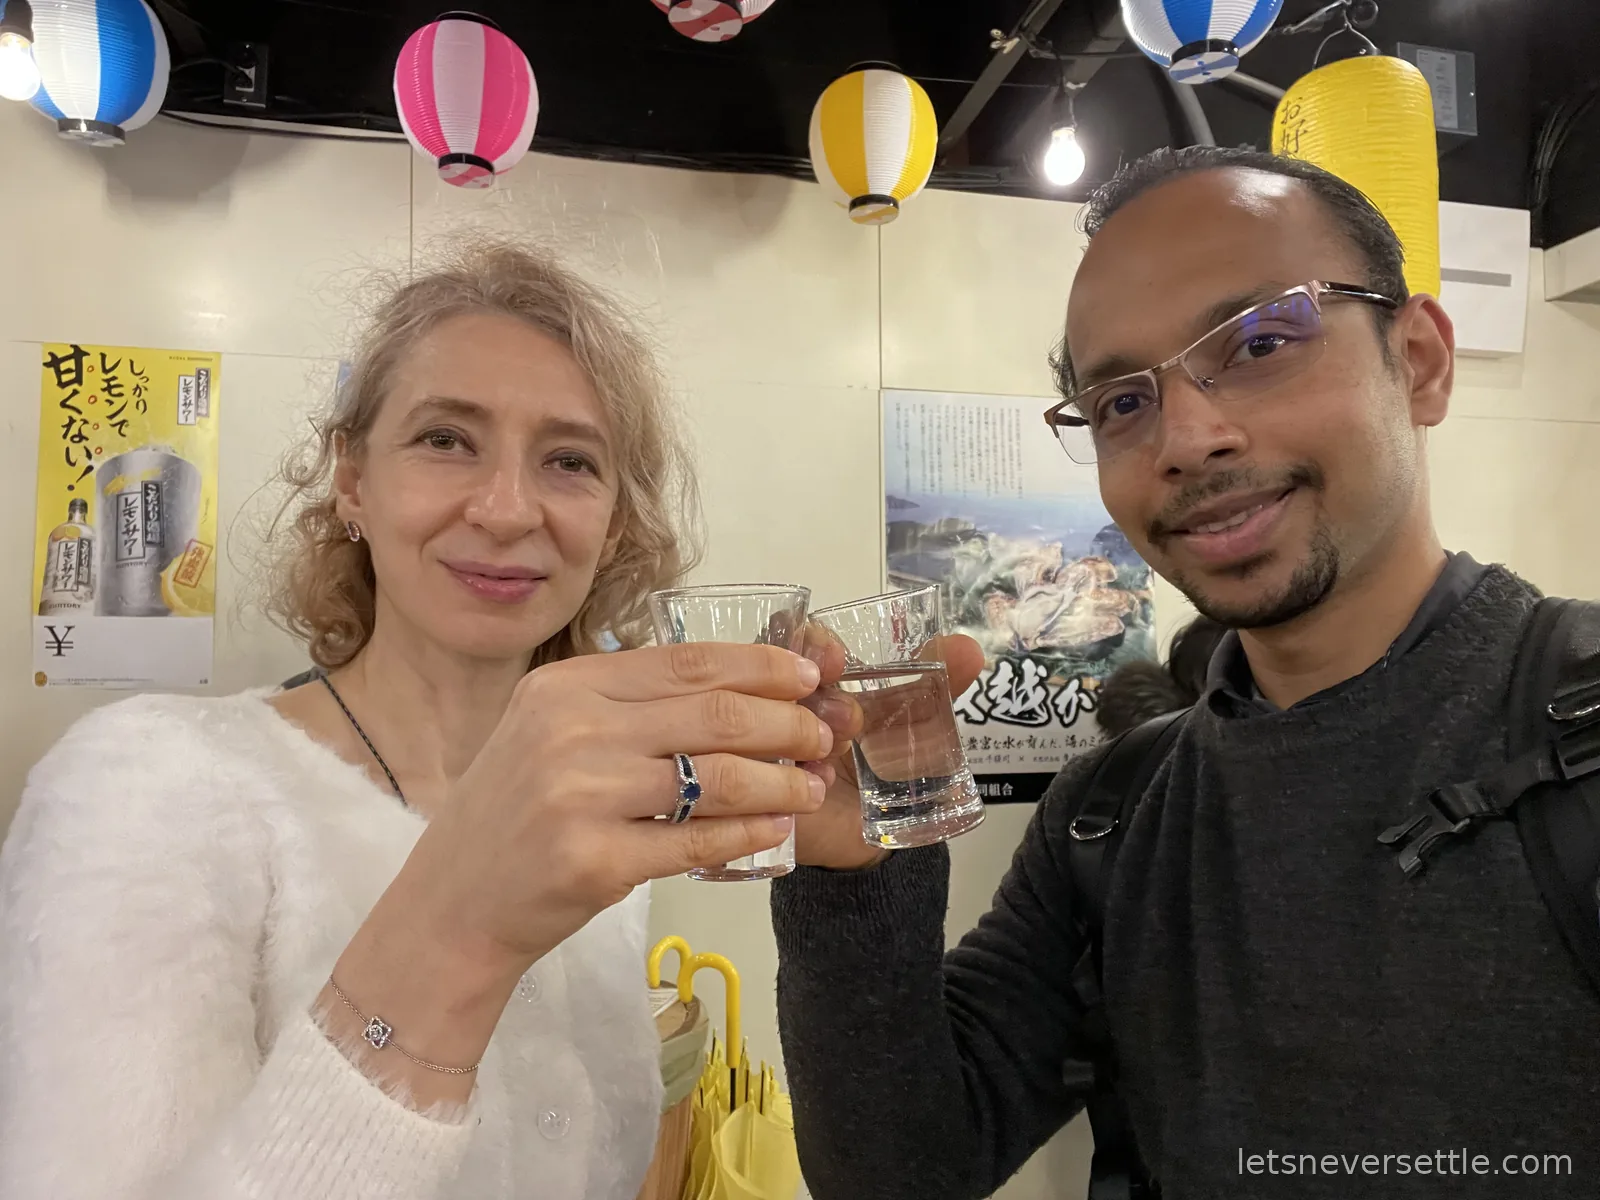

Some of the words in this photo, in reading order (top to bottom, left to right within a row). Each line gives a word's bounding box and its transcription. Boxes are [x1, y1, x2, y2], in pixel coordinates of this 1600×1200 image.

[100, 352, 129, 437] レモンで
[129, 358, 149, 415] しっかり
[181, 377, 194, 423] レモンサワー
[121, 496, 141, 556] レモンサワー
[953, 657, 1103, 728] 越か
